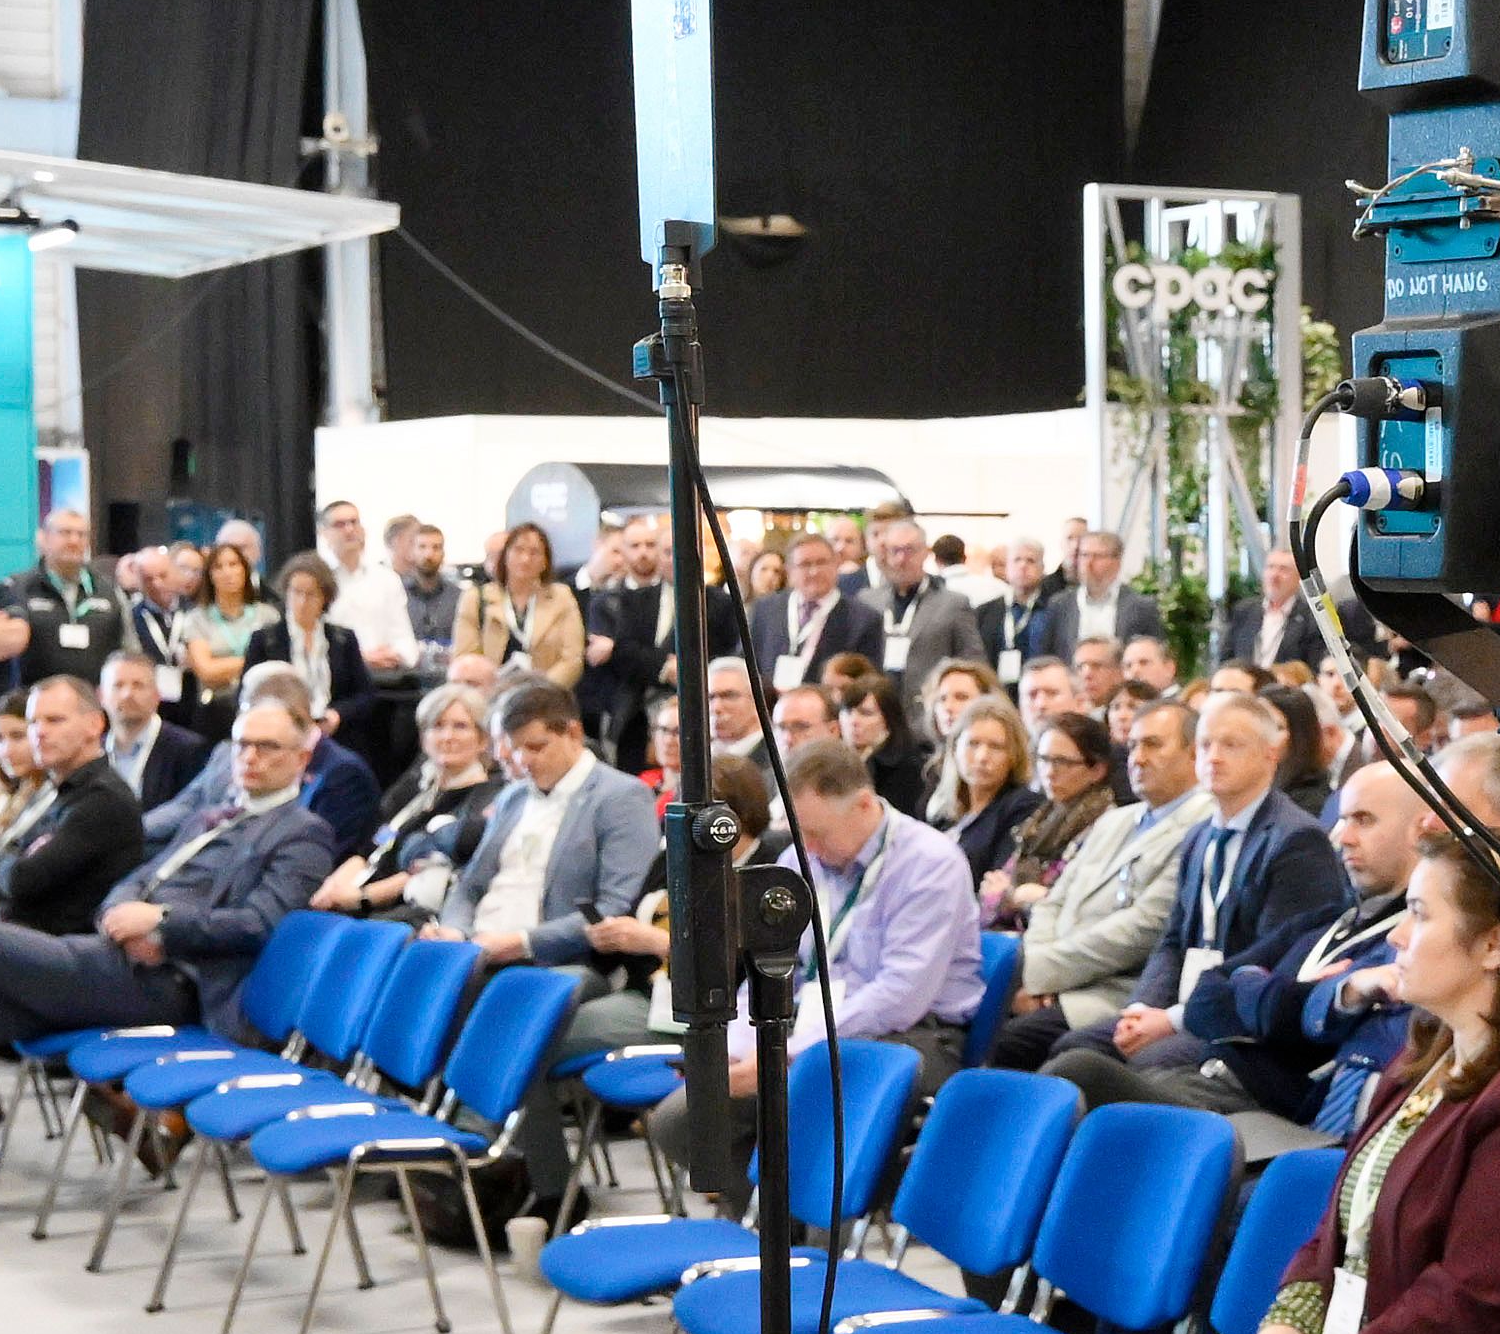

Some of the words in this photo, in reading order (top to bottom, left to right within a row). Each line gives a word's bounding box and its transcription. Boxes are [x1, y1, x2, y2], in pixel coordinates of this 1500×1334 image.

[1112, 263, 1269, 322] cpac
[1387, 278, 1404, 300] DO
[1409, 274, 1438, 296] NOT
[1443, 271, 1488, 295] HANG
[710, 826, 738, 835] K&M
